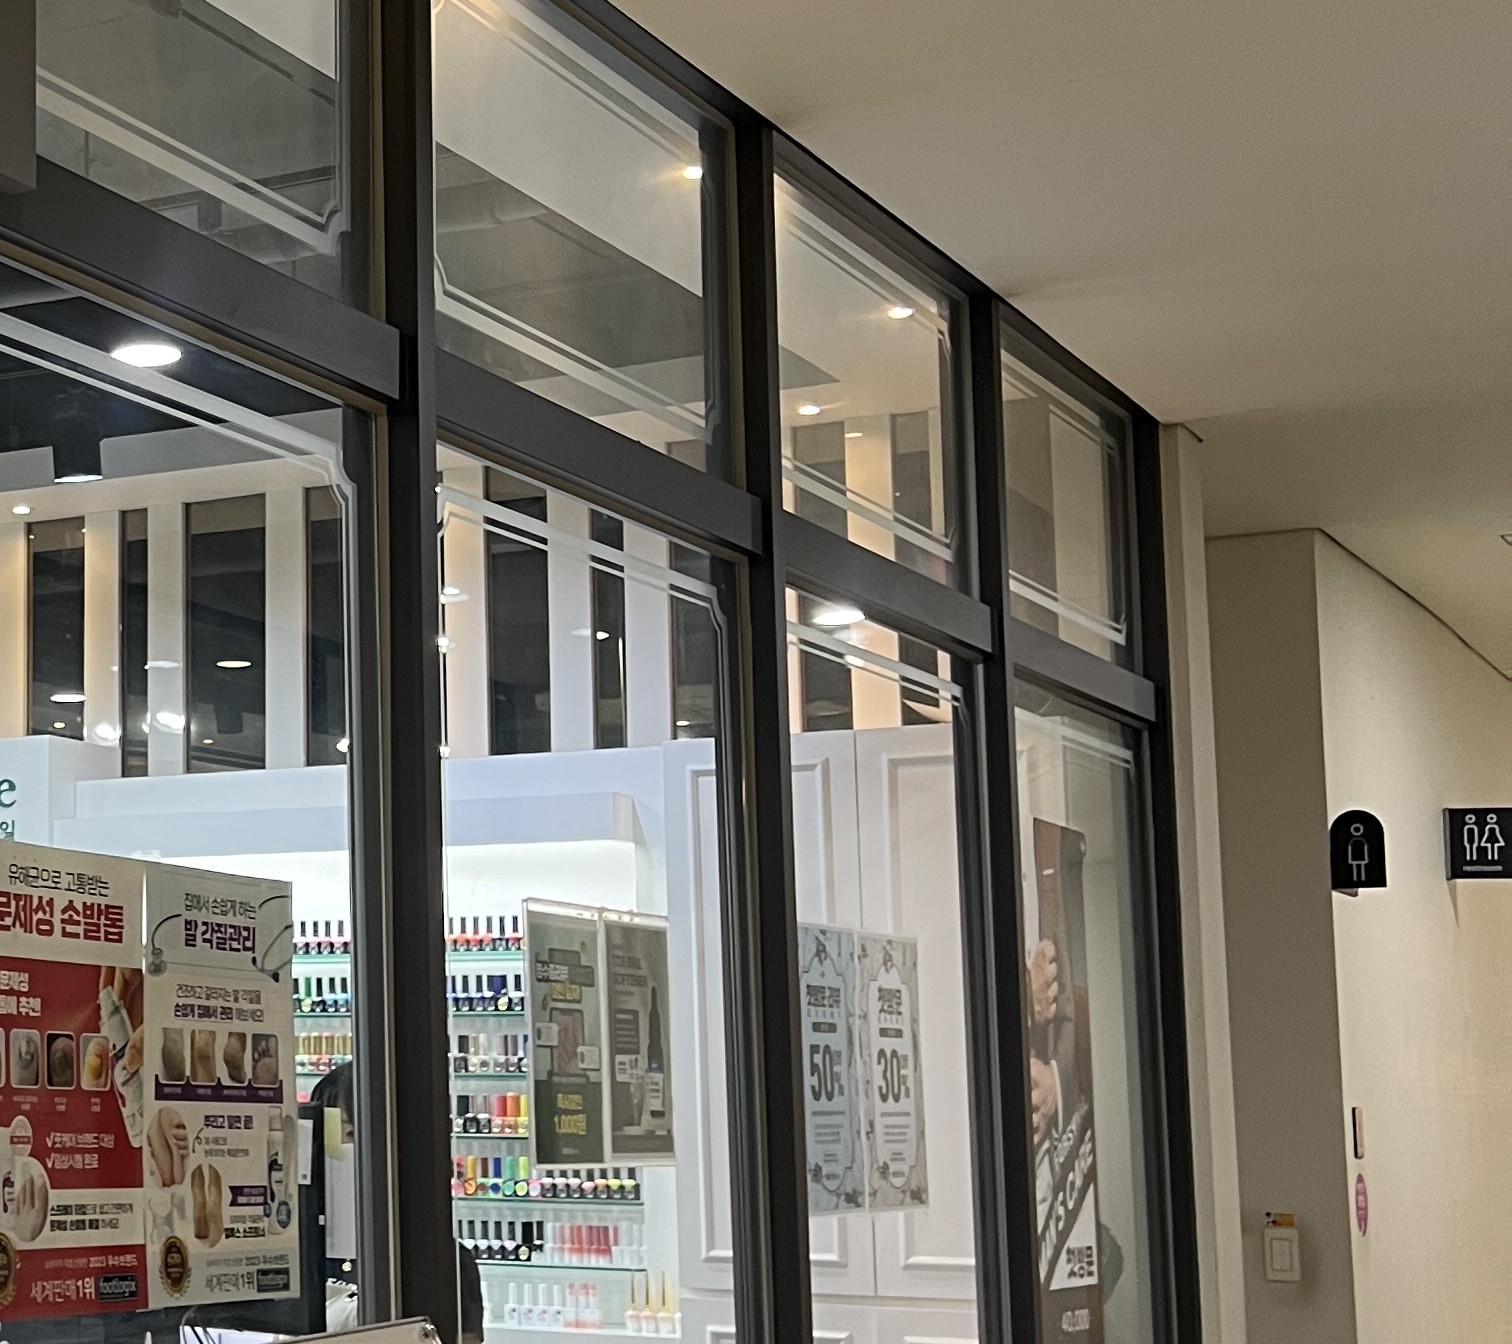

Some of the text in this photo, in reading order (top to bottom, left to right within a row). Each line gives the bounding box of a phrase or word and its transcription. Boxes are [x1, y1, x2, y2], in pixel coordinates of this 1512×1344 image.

[8, 863, 110, 898] 유해균으로 고통받는
[60, 899, 125, 944] 손발톱
[184, 892, 257, 920] 집에서 손쉽게 하는
[184, 918, 256, 955] 발 각질관리
